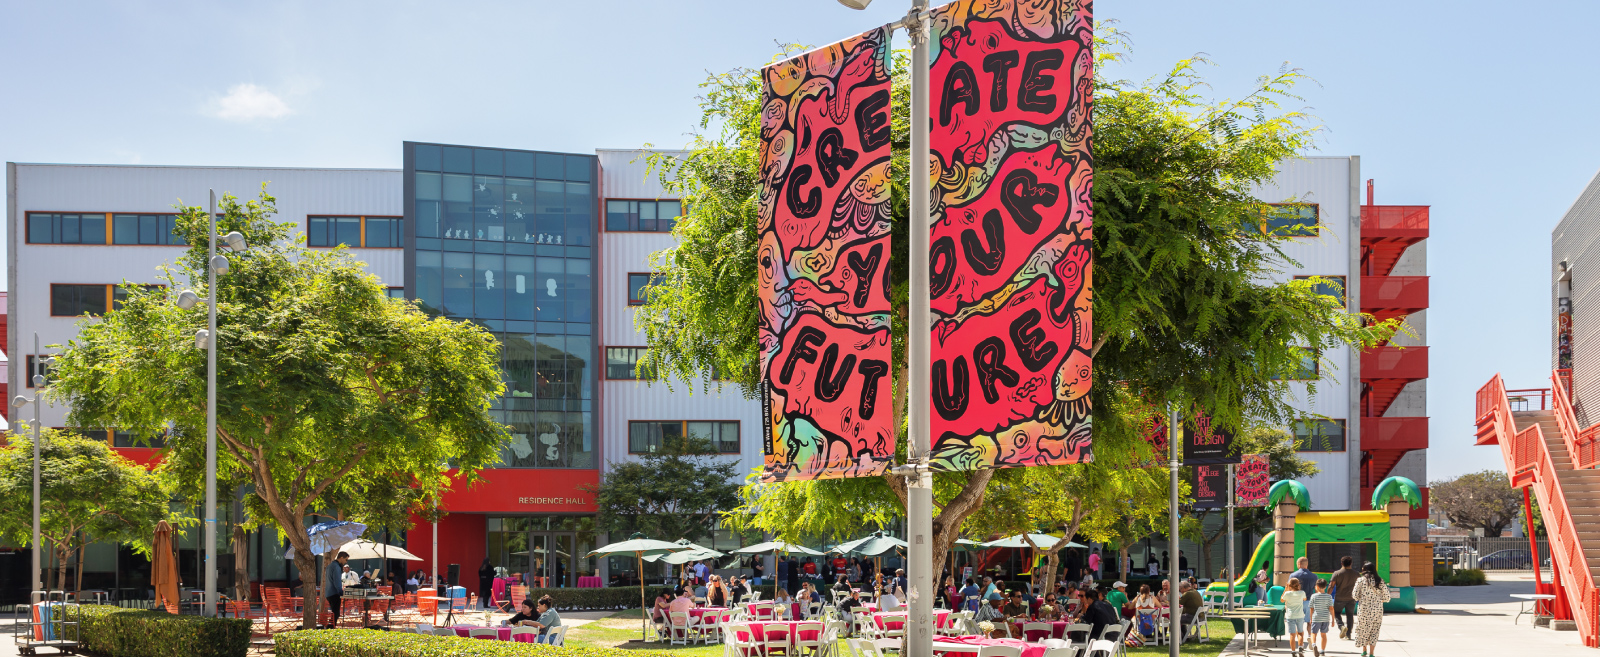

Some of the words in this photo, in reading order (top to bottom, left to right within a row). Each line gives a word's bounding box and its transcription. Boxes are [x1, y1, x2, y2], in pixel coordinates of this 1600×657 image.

[1193, 435, 1225, 445] DESIGN
[1239, 464, 1267, 476] CREATE
[1246, 475, 1267, 486] YOUR
[1237, 485, 1267, 497] FUTURE
[518, 497, 564, 505] RESIDENCE
[565, 497, 586, 505] HALL
